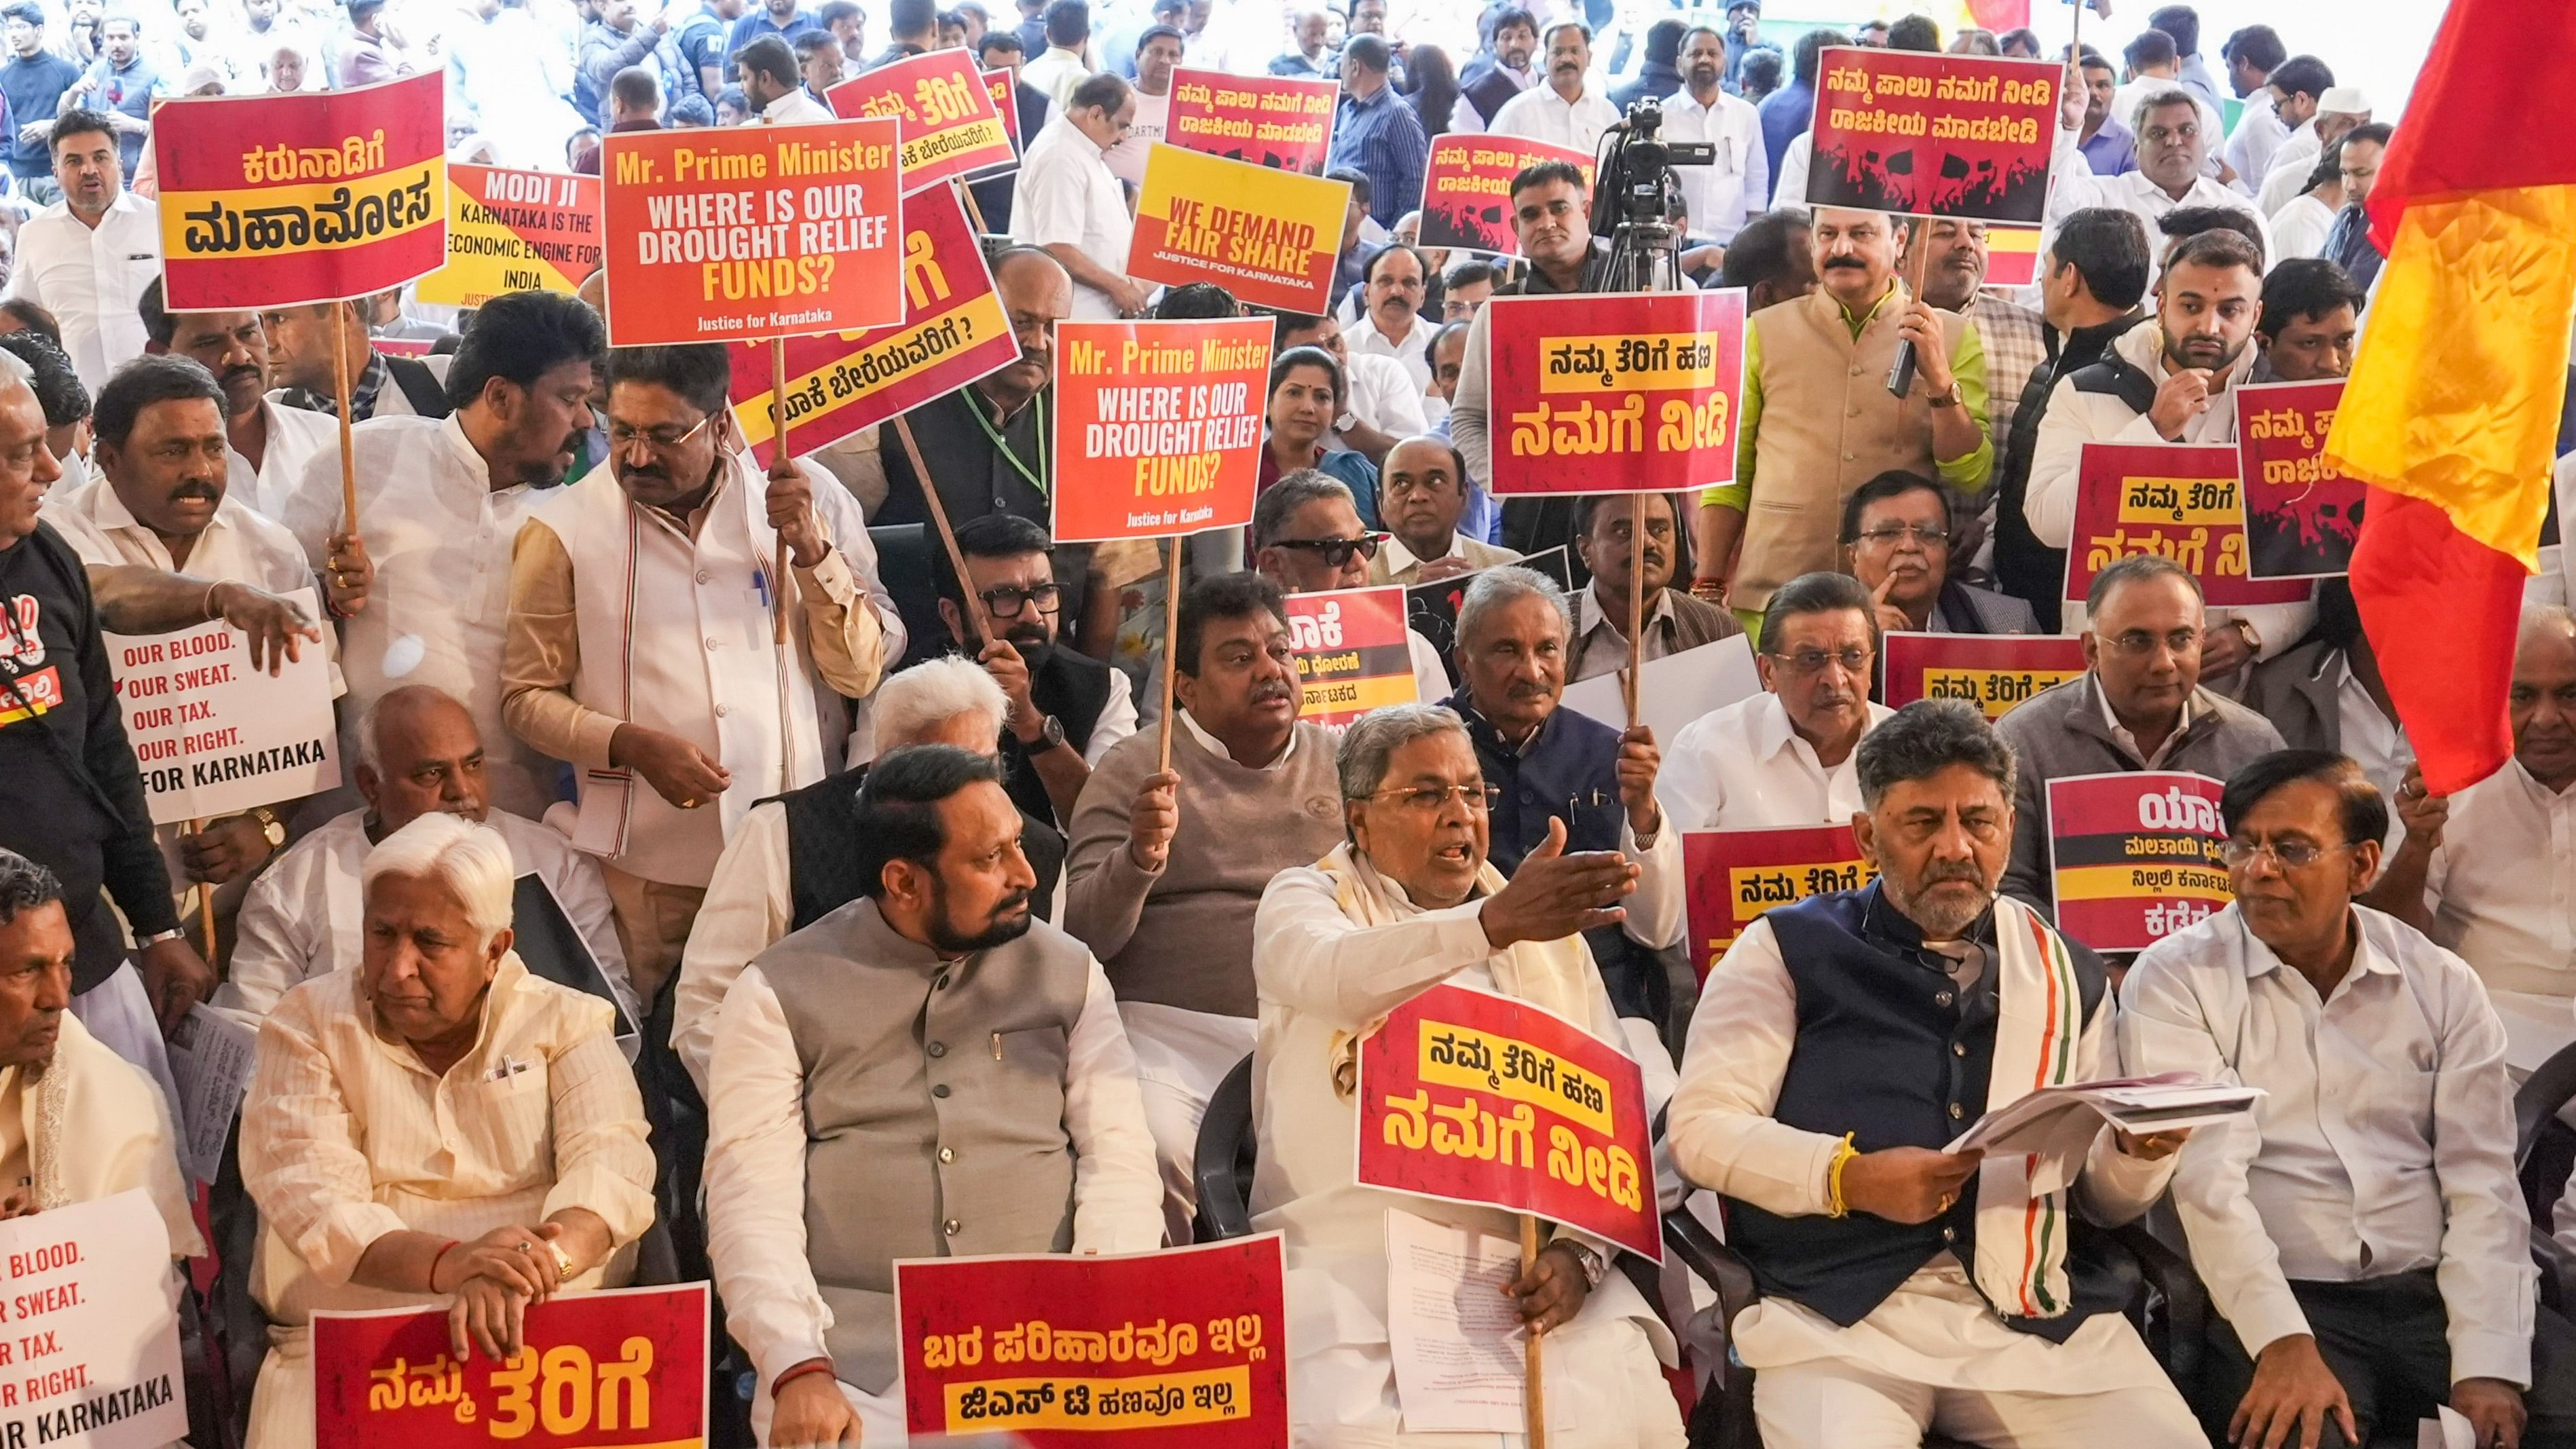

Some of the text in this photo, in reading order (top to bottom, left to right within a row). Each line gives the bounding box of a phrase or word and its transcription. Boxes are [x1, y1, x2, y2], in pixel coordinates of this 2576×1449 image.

[914, 71, 979, 126] ತೆರಿಗೆ
[1176, 83, 1331, 114] ನಮ್ಮ ಪಾಲು ನಮಗೆ ನೀಡಿ
[1827, 66, 2051, 106] ನಮ್ಮ ಪಾಲು ನಮಗೆ ನೀಡಿ
[1178, 115, 1323, 143] ರಾಜಕೀಯ ಮಾಡಬೇಡಿ
[1829, 107, 2038, 144] ರಾಜಕೀಯ ಮಾಡಬೇಡಿ
[243, 128, 385, 183] ಕರುನಾಡಿಗೆ
[616, 140, 893, 185] Mr. Prime Minister
[1435, 146, 1471, 172] ನಮ್ಮ
[1472, 149, 1515, 168] ಪಾಲು
[485, 171, 578, 207] MODI JI
[648, 183, 863, 229] WHERE IS OUR
[185, 170, 430, 252] ಮಹಾಮೋಸ
[461, 204, 593, 233] KARNATAKA IS THE
[1170, 196, 1315, 250] WE DEMAND
[525, 240, 573, 263] ENGINE
[576, 245, 601, 264] FOR
[637, 214, 888, 265] DROUGHT RELIEF
[1164, 221, 1313, 276] FAIR SHARE
[504, 269, 541, 290] INDIA
[703, 255, 836, 301] FUNDS?
[1153, 250, 1314, 290] JUSTICE FOR KARNATAKA
[696, 307, 832, 332] Justice for Karnataka
[1069, 339, 1269, 375] Mr. Prime Minister
[1550, 338, 1711, 387] ನಮ್ಮ ತೆರಿಗೆ ಹಣ
[1097, 382, 1248, 422] WHERE IS OUR
[1086, 415, 1258, 458] DROUGHT RELIEF
[1511, 391, 1729, 456] ನಮಗೆ ನೀಡಿ
[2250, 408, 2315, 449] ನಮ್ಮ
[1135, 451, 1221, 496] FUNDS?
[1126, 506, 1213, 528] Justice for Karnataka
[2129, 483, 2235, 521] ನಮ್ಮ ತೆರಿಗೆ
[124, 632, 236, 667] OUR BLOOD.
[129, 664, 237, 698] OUR SWEAT.
[1985, 674, 2032, 702] ತೆರಿಗೆ
[134, 700, 217, 730] OUR TAX.
[138, 727, 244, 761] OUR RIGHT.
[141, 738, 326, 795] FOR KARNATAKA
[2125, 835, 2198, 856] ಮಲತಾಯಿ
[1430, 1032, 1603, 1114] ನಮ್ಮ ತೆರಿಗೆ ಹಣ
[1383, 1088, 1642, 1213] ನಮಗೆ ನೀಡಿ
[10, 1241, 85, 1279] BLOOD.
[15, 1282, 86, 1319] SWEAT.
[20, 1330, 63, 1361] TAX.
[922, 1313, 1267, 1369] ಬರ ಪರಿಹಾರವೂ ಇಲ್ಲ
[26, 1363, 94, 1403] RIGHT.
[369, 1336, 654, 1439] ನಮ್ಮ ತೆರಿಗೆ
[1098, 1382, 1184, 1417] ಹಣವೂ
[1192, 1380, 1235, 1417] ಇಲ್ಲ
[37, 1373, 174, 1444] KARNATAKA
